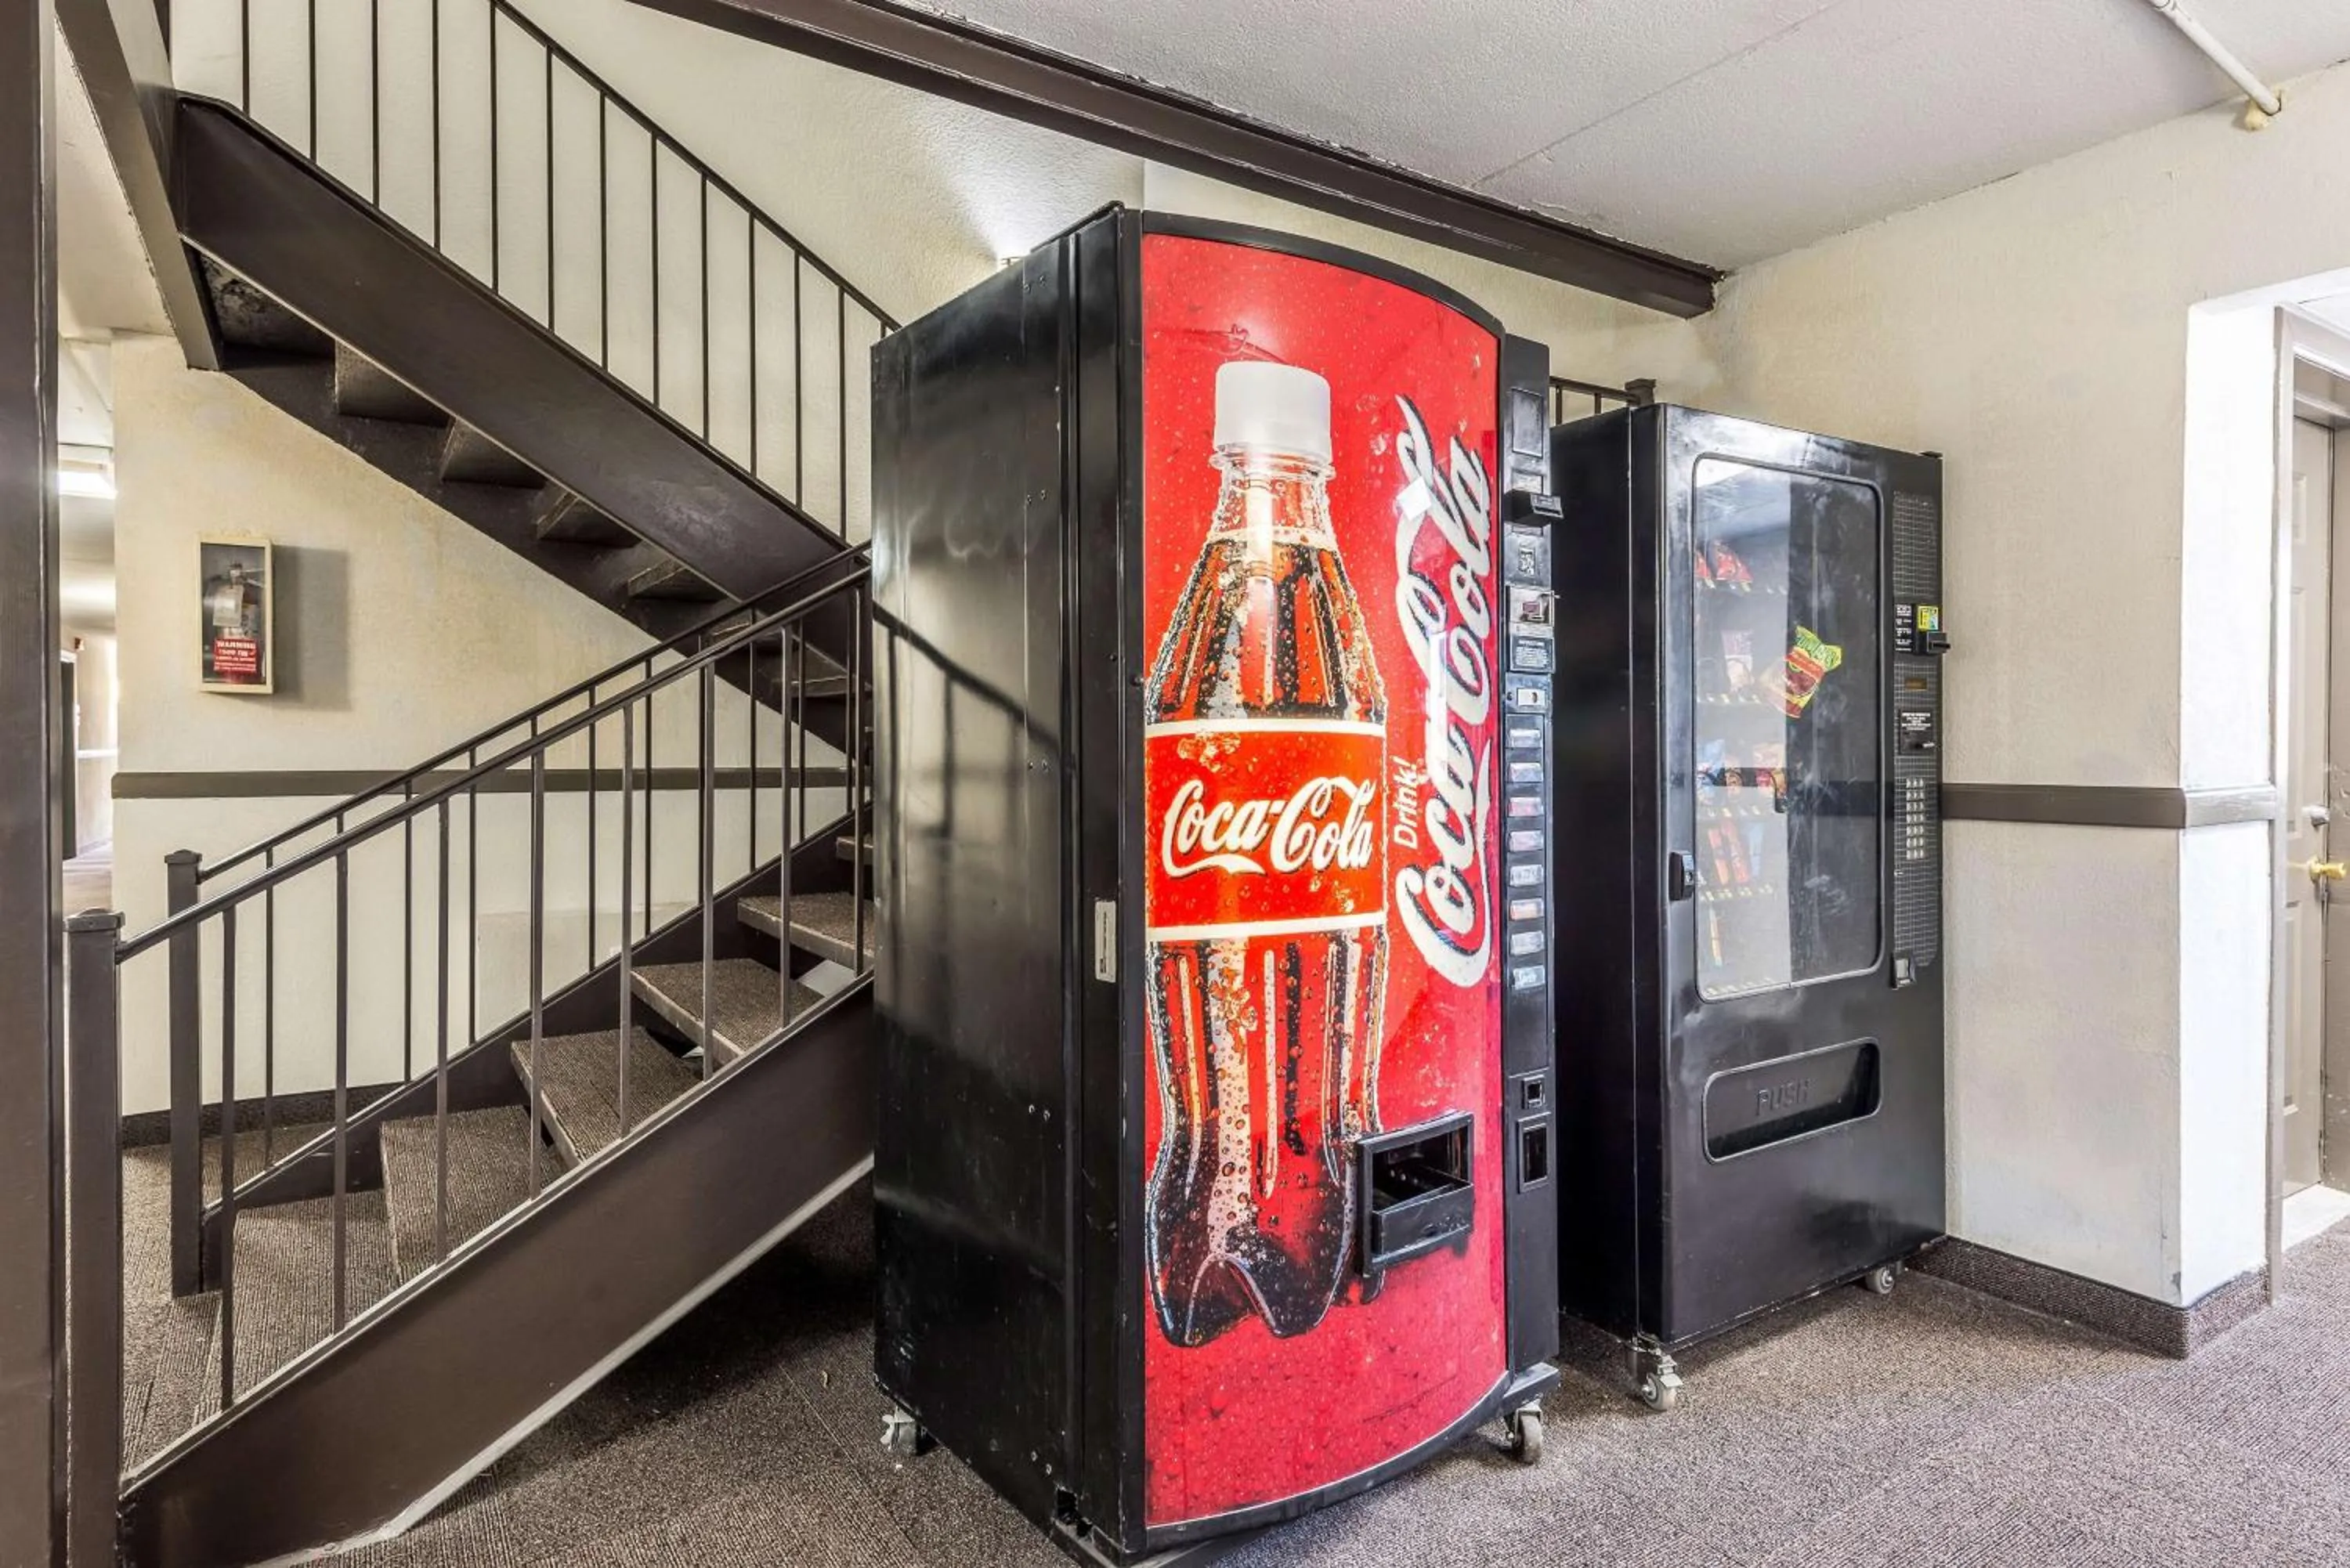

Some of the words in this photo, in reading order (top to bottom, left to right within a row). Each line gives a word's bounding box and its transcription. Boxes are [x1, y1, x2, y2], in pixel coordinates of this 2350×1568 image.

[1162, 776, 1376, 876] Coca-Cola
[1392, 756, 1419, 850] Drink!
[1756, 1078, 1810, 1116] PUSH
